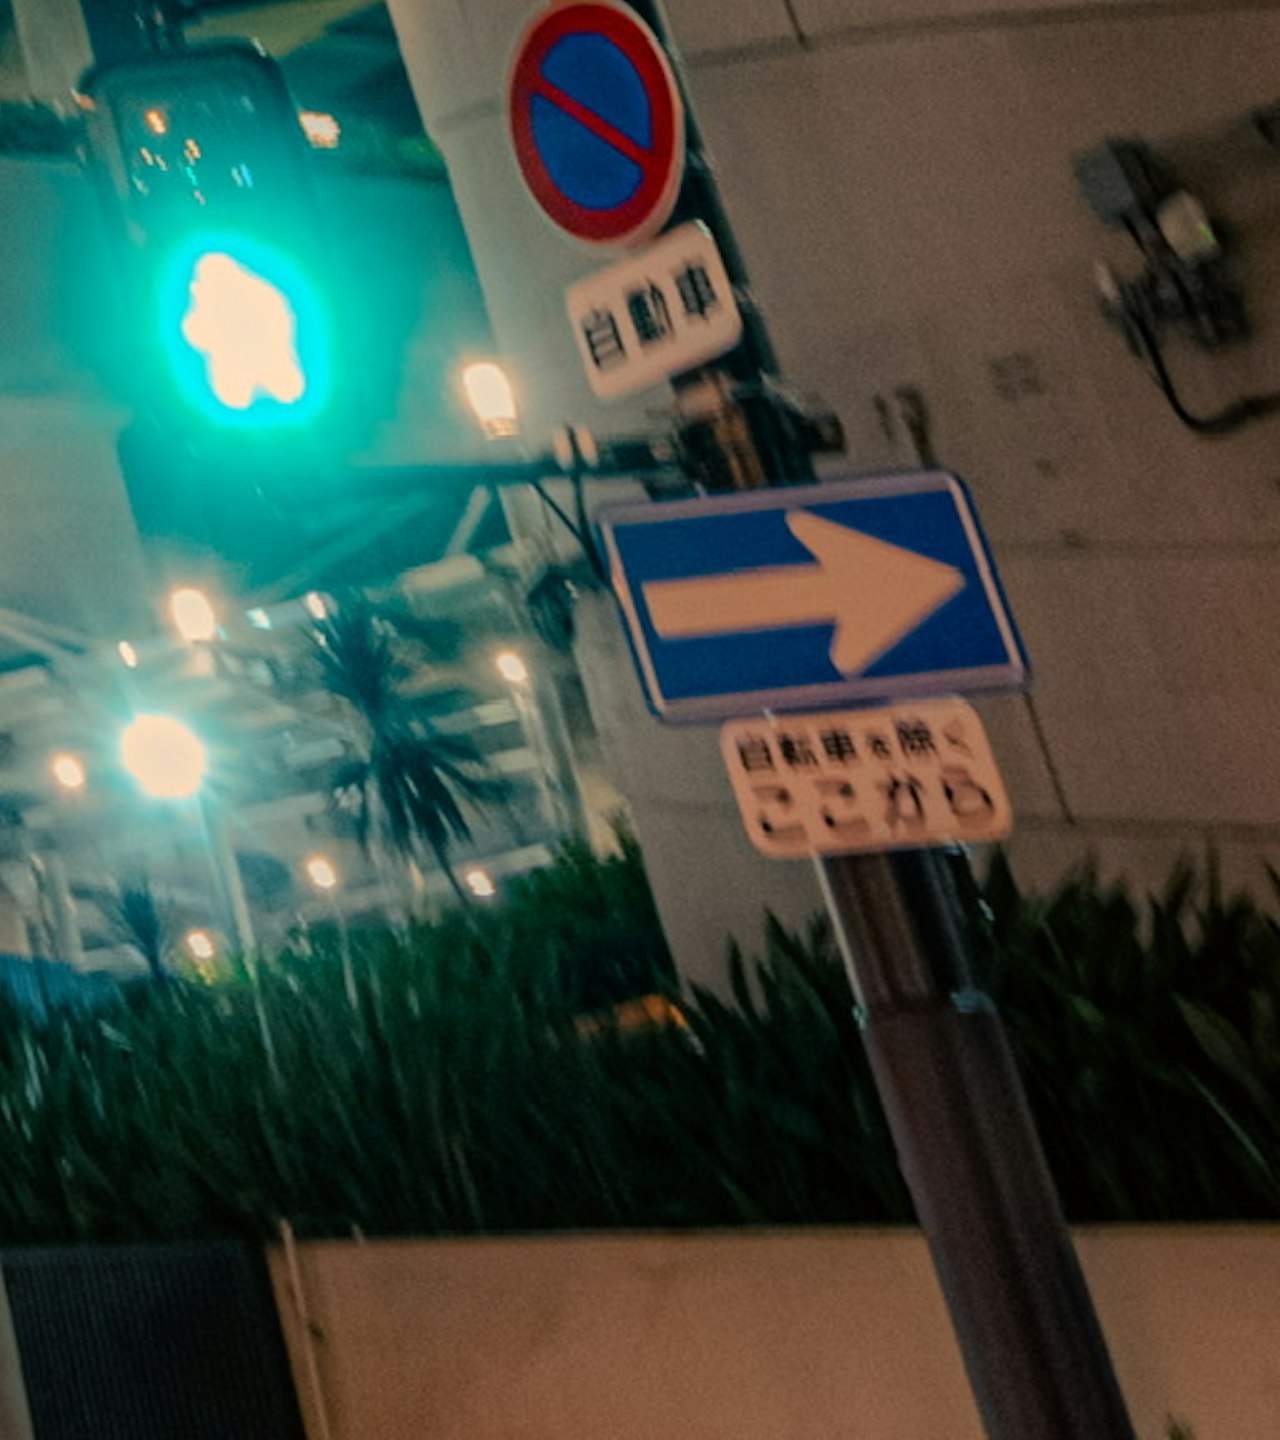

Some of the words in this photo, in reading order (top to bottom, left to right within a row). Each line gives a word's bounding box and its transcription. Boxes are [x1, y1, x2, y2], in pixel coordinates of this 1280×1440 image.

[581, 262, 718, 370] 自動車
[735, 718, 973, 772] 自転車を除く
[748, 765, 996, 840] ここから
